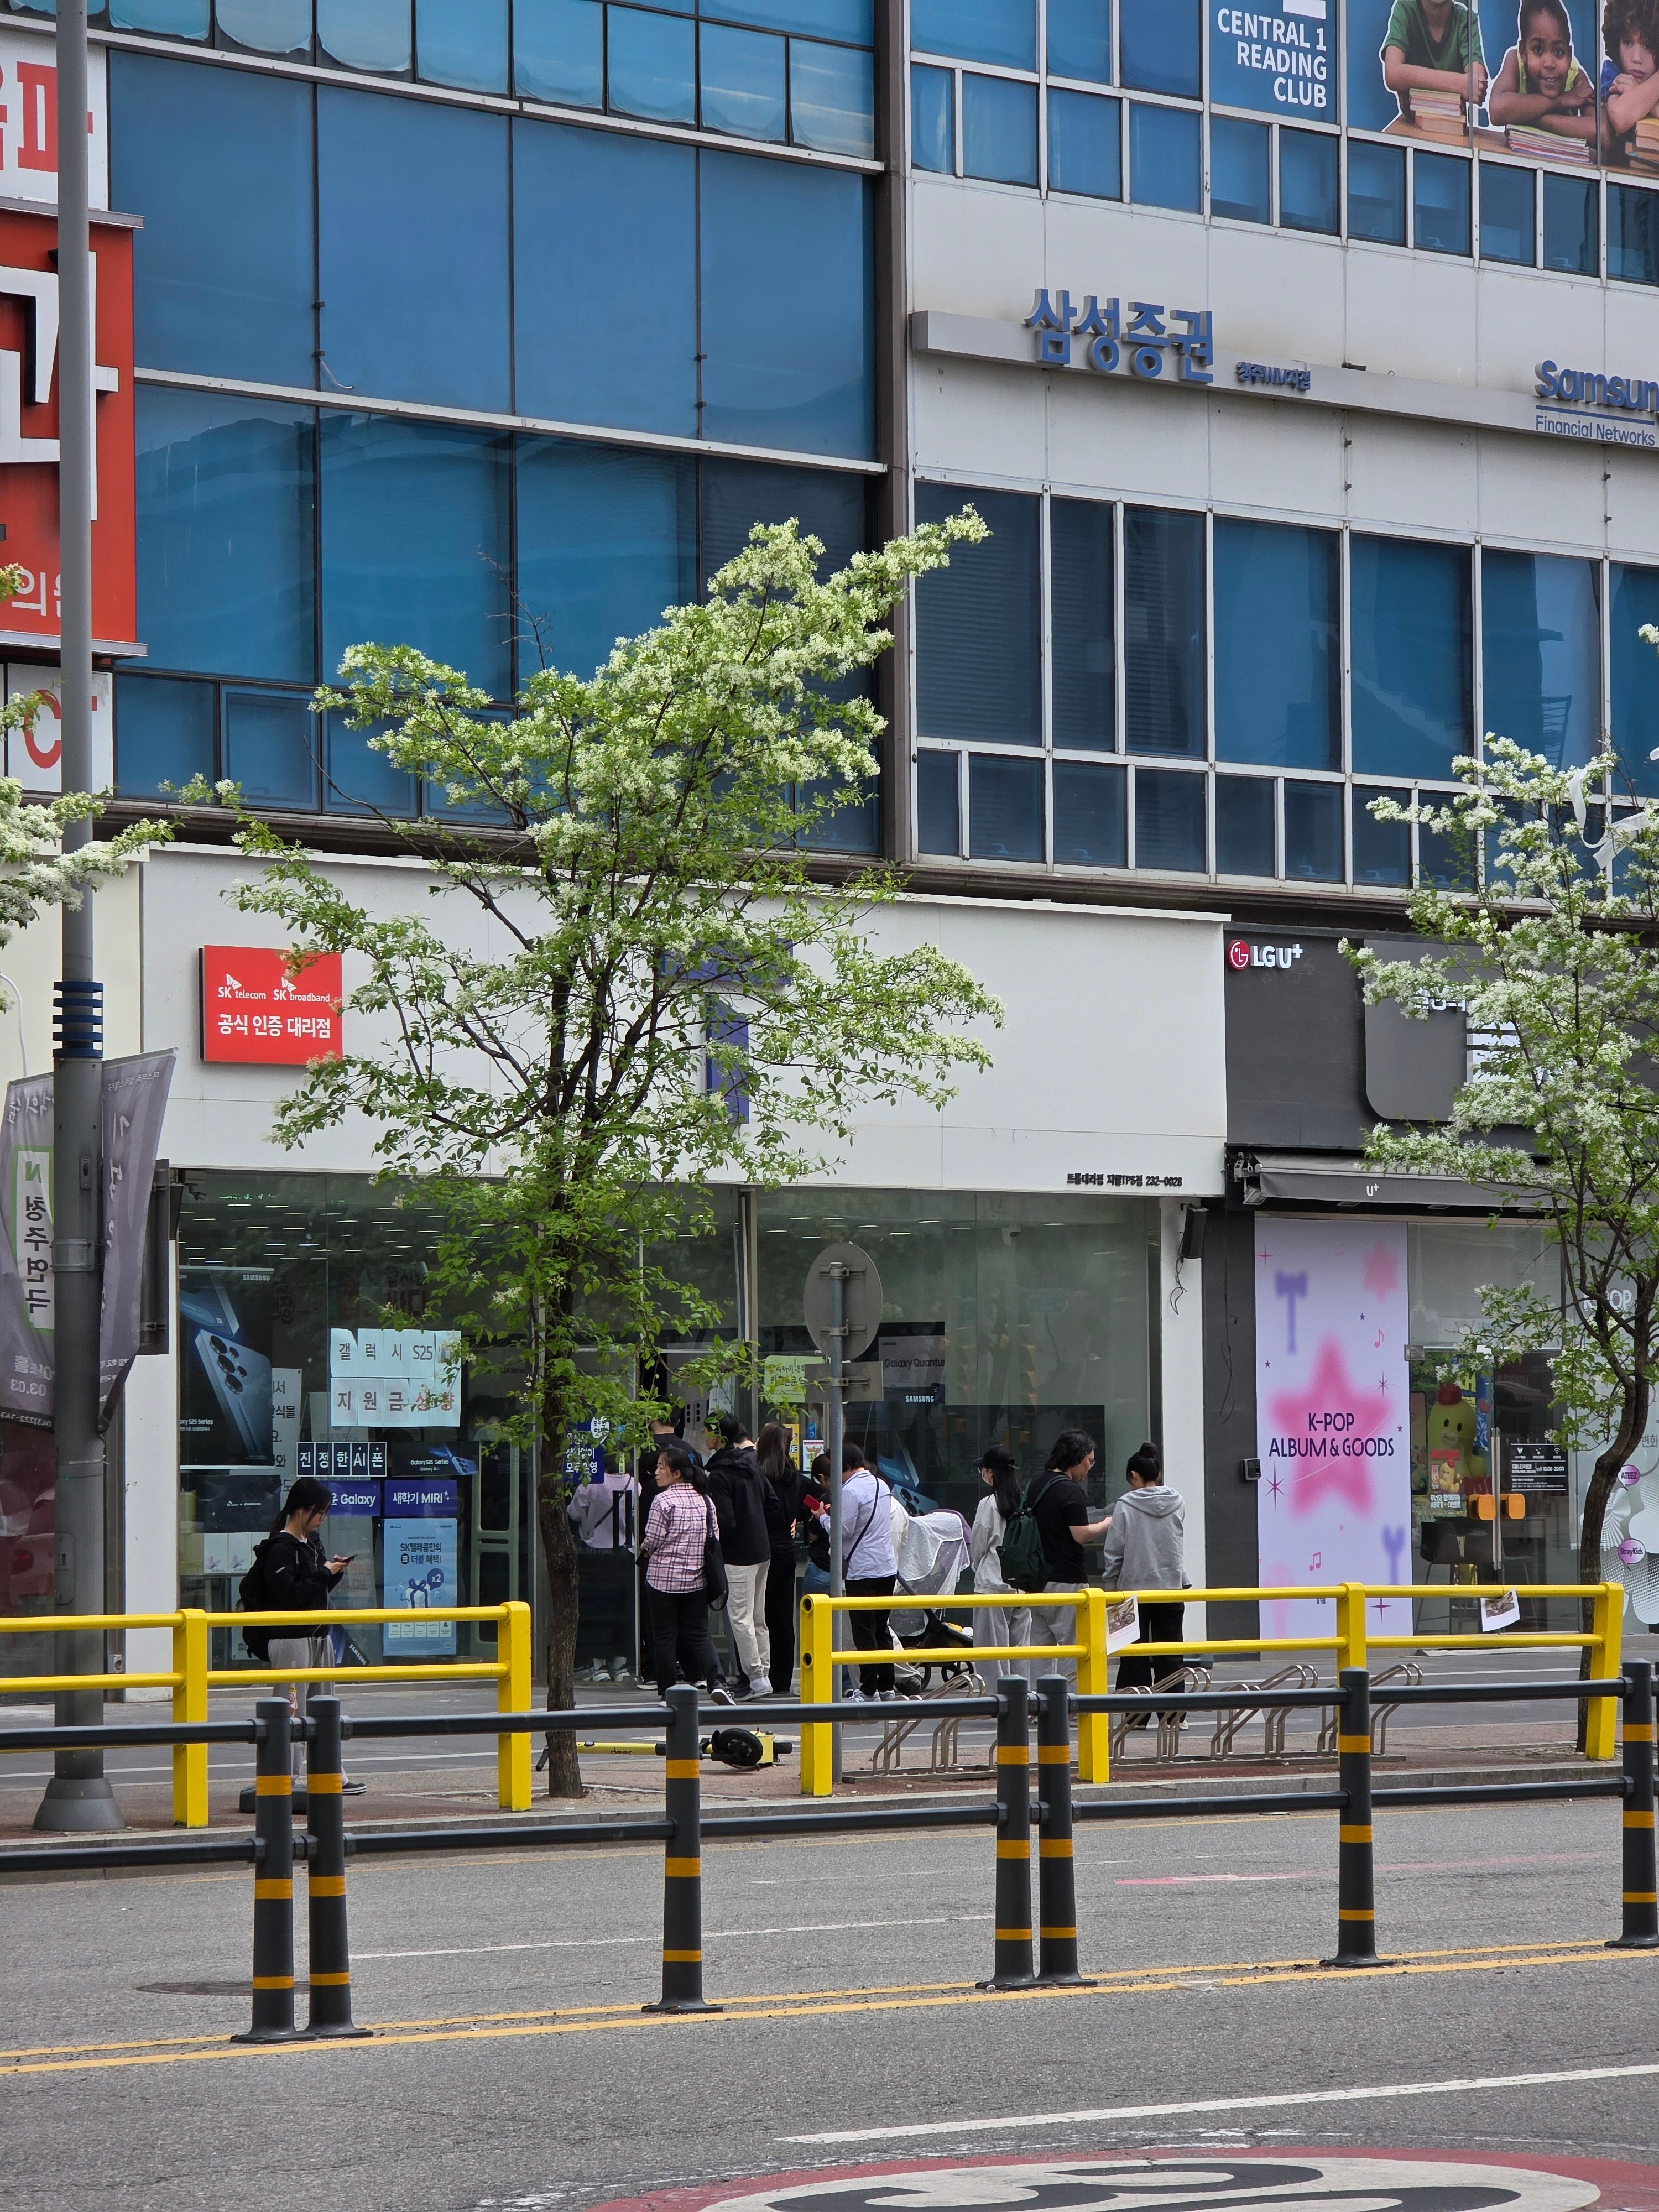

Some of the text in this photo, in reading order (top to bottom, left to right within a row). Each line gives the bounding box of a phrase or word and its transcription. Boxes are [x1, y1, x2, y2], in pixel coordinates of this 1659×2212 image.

[1217, 8, 1327, 51] CENTRAL 1
[1237, 41, 1327, 80] READING
[1274, 77, 1327, 108] CLUB
[1024, 288, 1214, 383] 삼성증권
[1535, 415, 1656, 447] Financial Networks
[218, 986, 330, 1003] SK telecom SK broadband
[218, 1014, 331, 1039] 공식 인증 대리점
[413, 1345, 433, 1360] S25
[884, 1359, 912, 1370] Galaxy
[1308, 1412, 1354, 1432] K-POP
[1269, 1437, 1394, 1457] ALBUM & GOODS
[1620, 1472, 1637, 1480] ATEEZ
[340, 1493, 376, 1507] Galaxy
[392, 1492, 443, 1505] 새학기 MIRI
[400, 1542, 442, 1552] SK텔레콤만의
[411, 1554, 424, 1564] 더블
[349, 1644, 367, 1666] SAMSUNG
